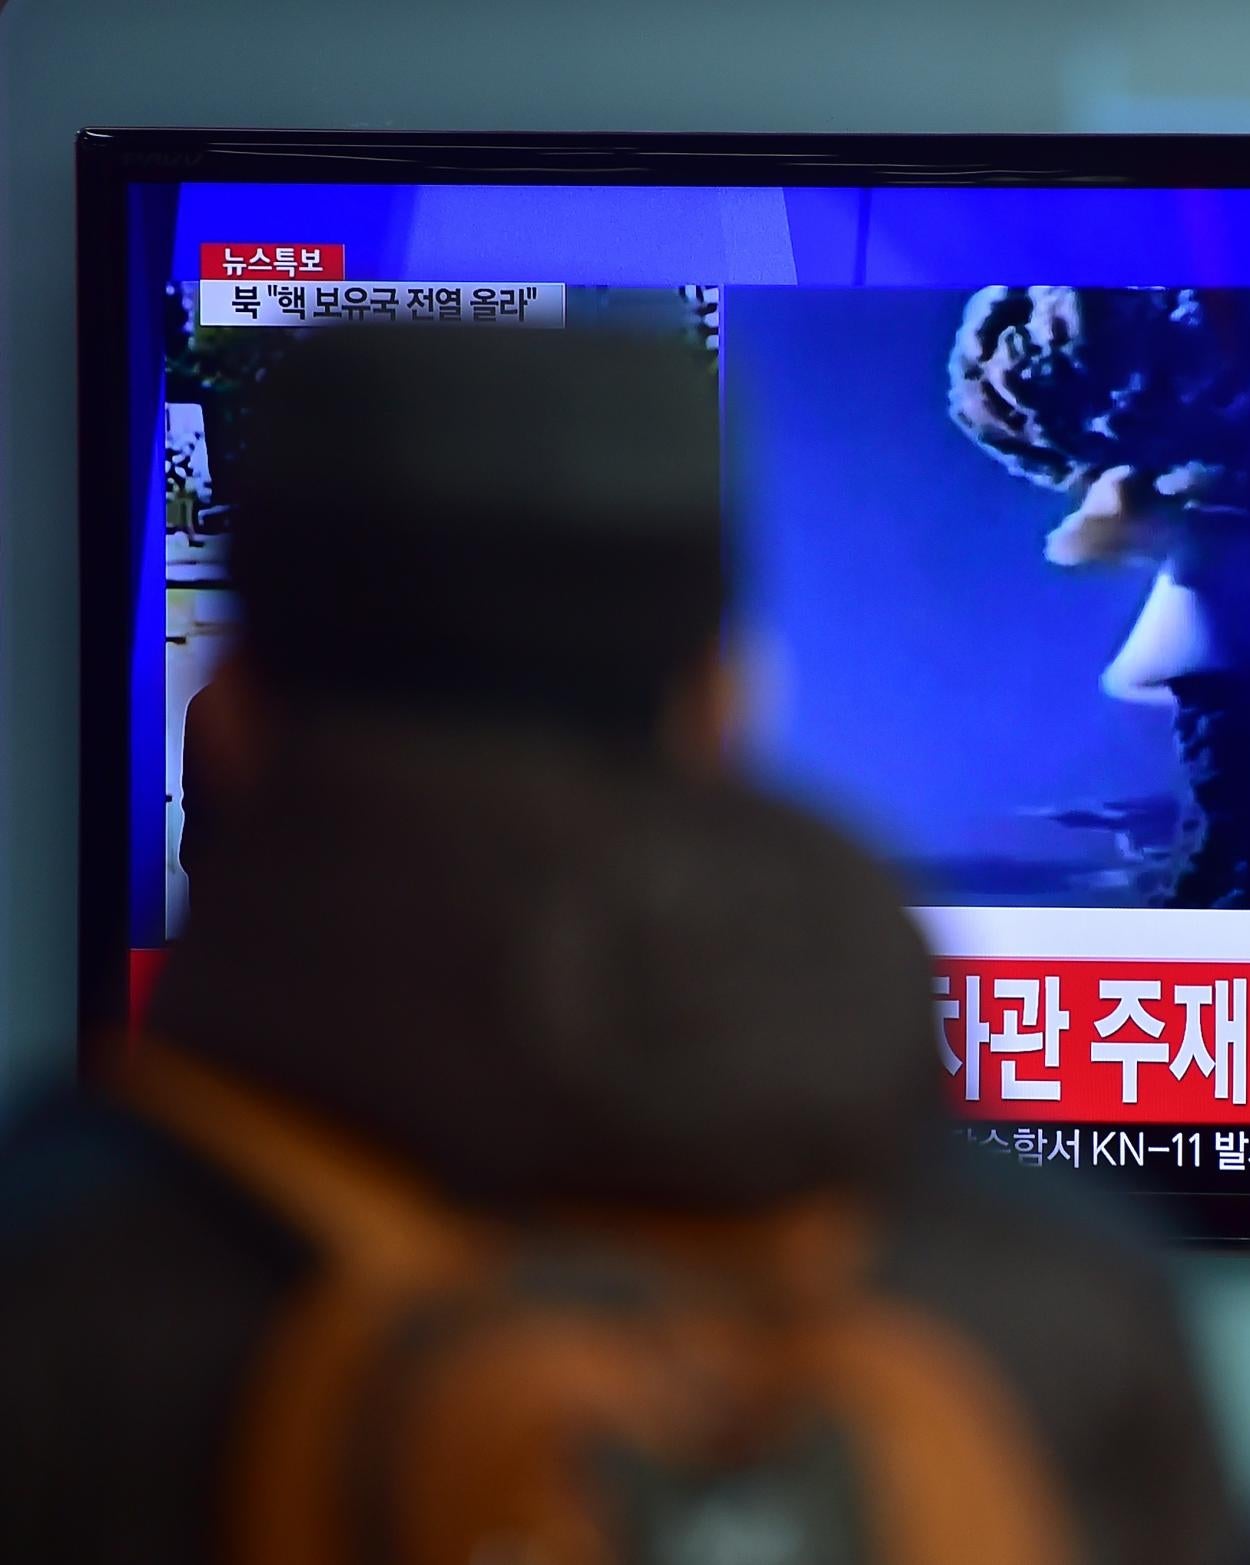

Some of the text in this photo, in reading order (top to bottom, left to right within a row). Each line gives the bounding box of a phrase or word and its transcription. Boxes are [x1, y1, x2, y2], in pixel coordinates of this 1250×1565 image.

[222, 247, 323, 277] 뉴스특보
[231, 285, 537, 321] 북 "핵 보유국 전열 올라"
[1090, 978, 1248, 1105] 주재
[1093, 1131, 1201, 1167] KN-11
